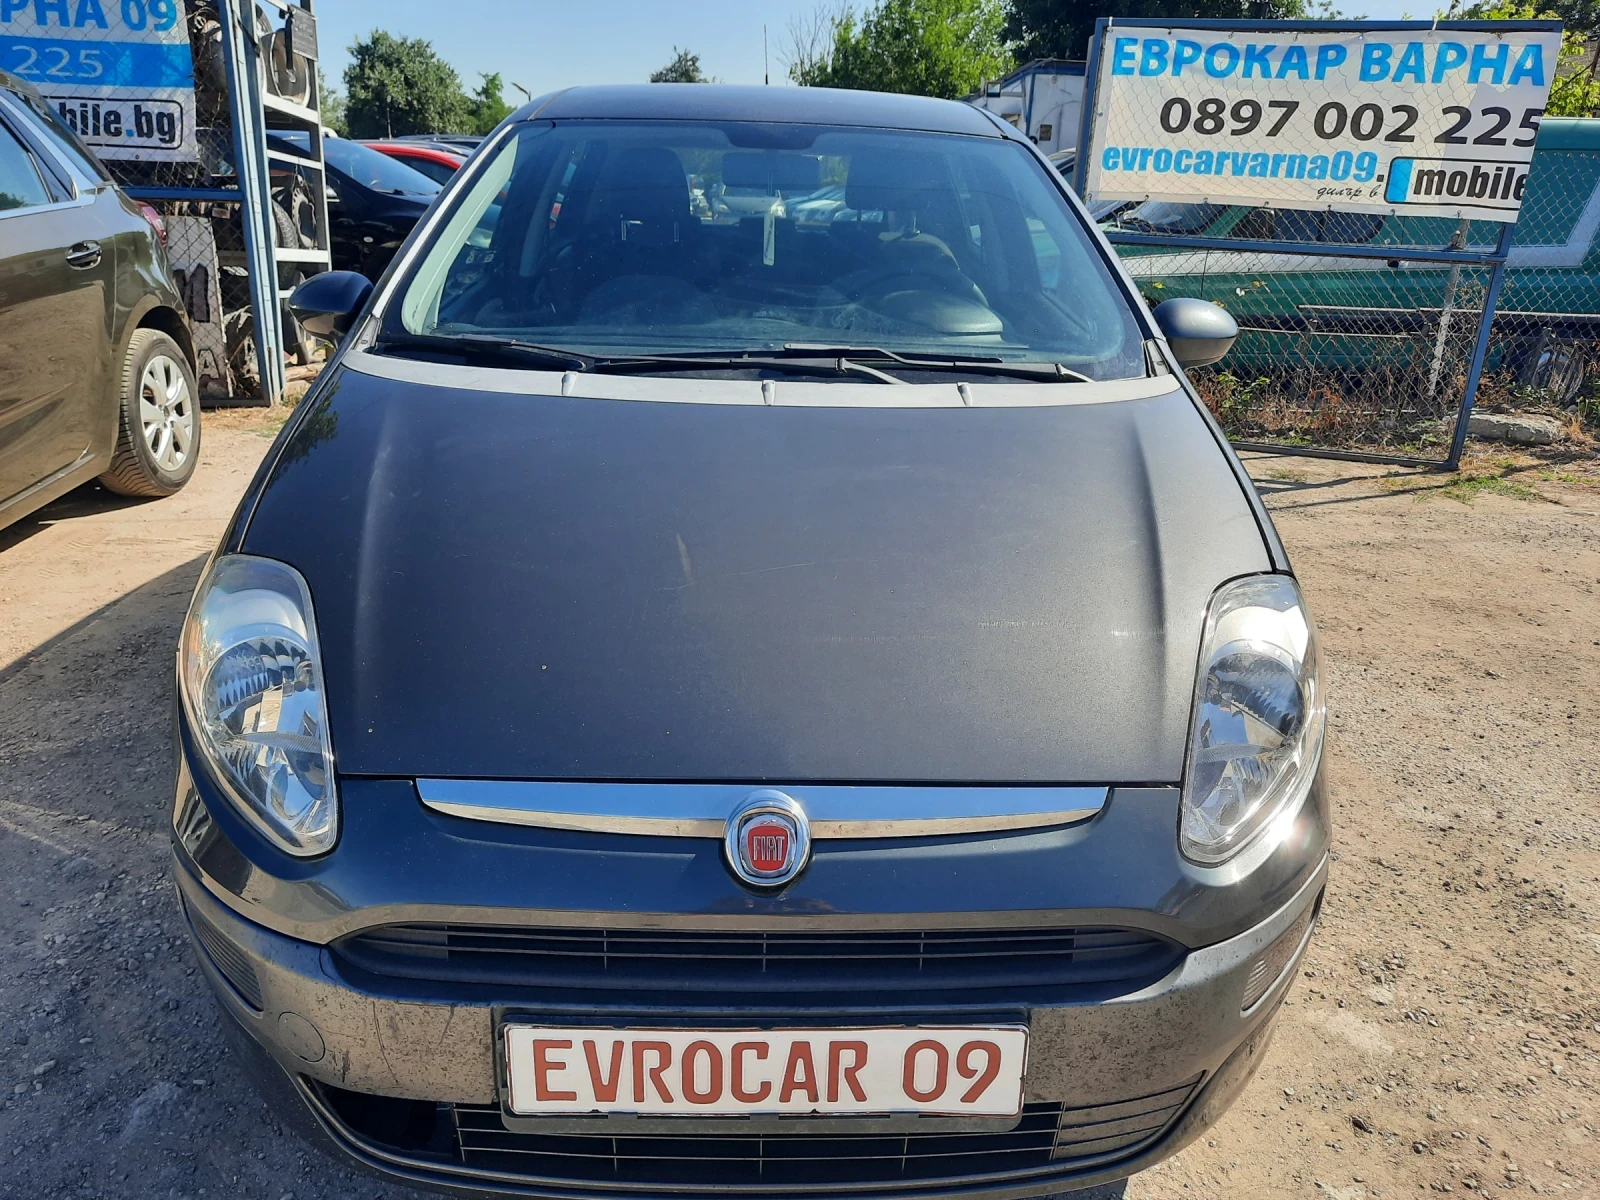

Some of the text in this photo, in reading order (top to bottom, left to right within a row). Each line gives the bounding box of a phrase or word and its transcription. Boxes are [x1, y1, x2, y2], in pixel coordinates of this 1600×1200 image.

[120, 0, 177, 32] 09
[12, 45, 104, 78] 225
[1111, 37, 1545, 86] ЕВРОКАР ВАРНА
[1160, 97, 1544, 147] 0897 002 225
[753, 836, 785, 861] FIAT
[532, 1039, 1002, 1104] EVROCAR 09
